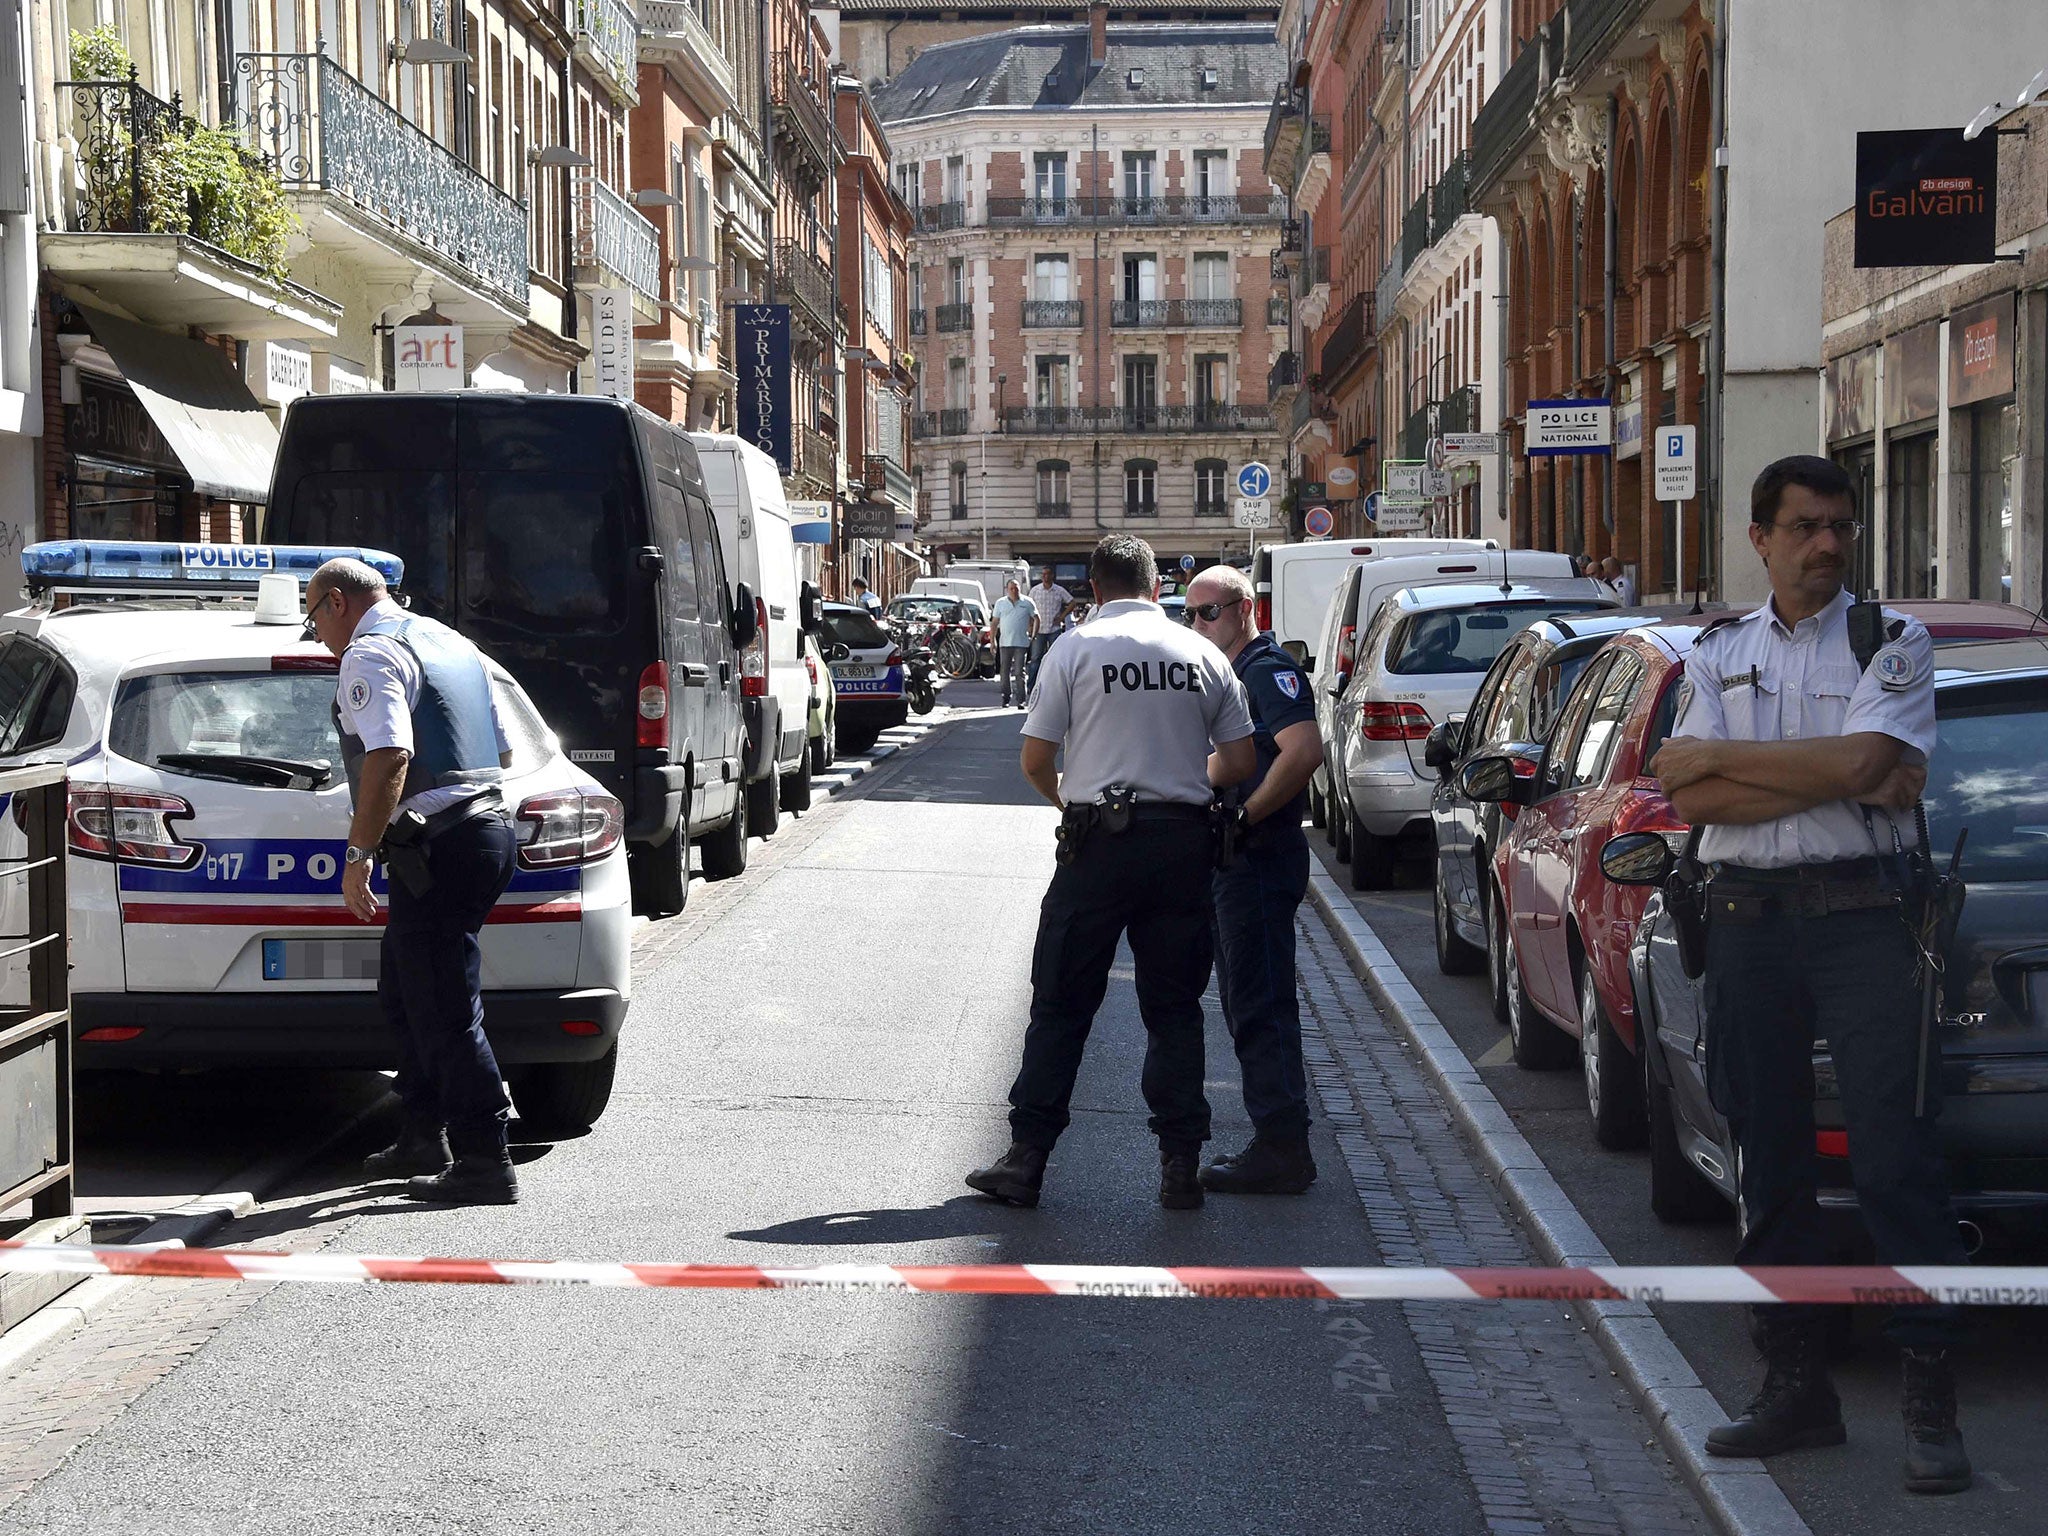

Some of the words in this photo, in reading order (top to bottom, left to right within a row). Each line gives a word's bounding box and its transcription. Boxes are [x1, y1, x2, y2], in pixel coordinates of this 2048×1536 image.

[1922, 180, 1935, 190] 2b
[1937, 179, 1970, 190] design
[1869, 186, 1984, 218] Galvani
[402, 332, 458, 369] art
[1974, 327, 1996, 369] design
[1541, 412, 1598, 424] POLICE
[1541, 433, 1598, 443] NATIONALE
[1670, 440, 1680, 456] P
[1243, 501, 1262, 509] SAUF
[850, 508, 887, 522] alain
[851, 524, 887, 534] Coiffeur
[185, 546, 268, 567] POLICE
[1102, 661, 1200, 693] POLICE
[837, 682, 877, 691] POLICE
[218, 853, 243, 880] 17
[271, 964, 277, 972] F
